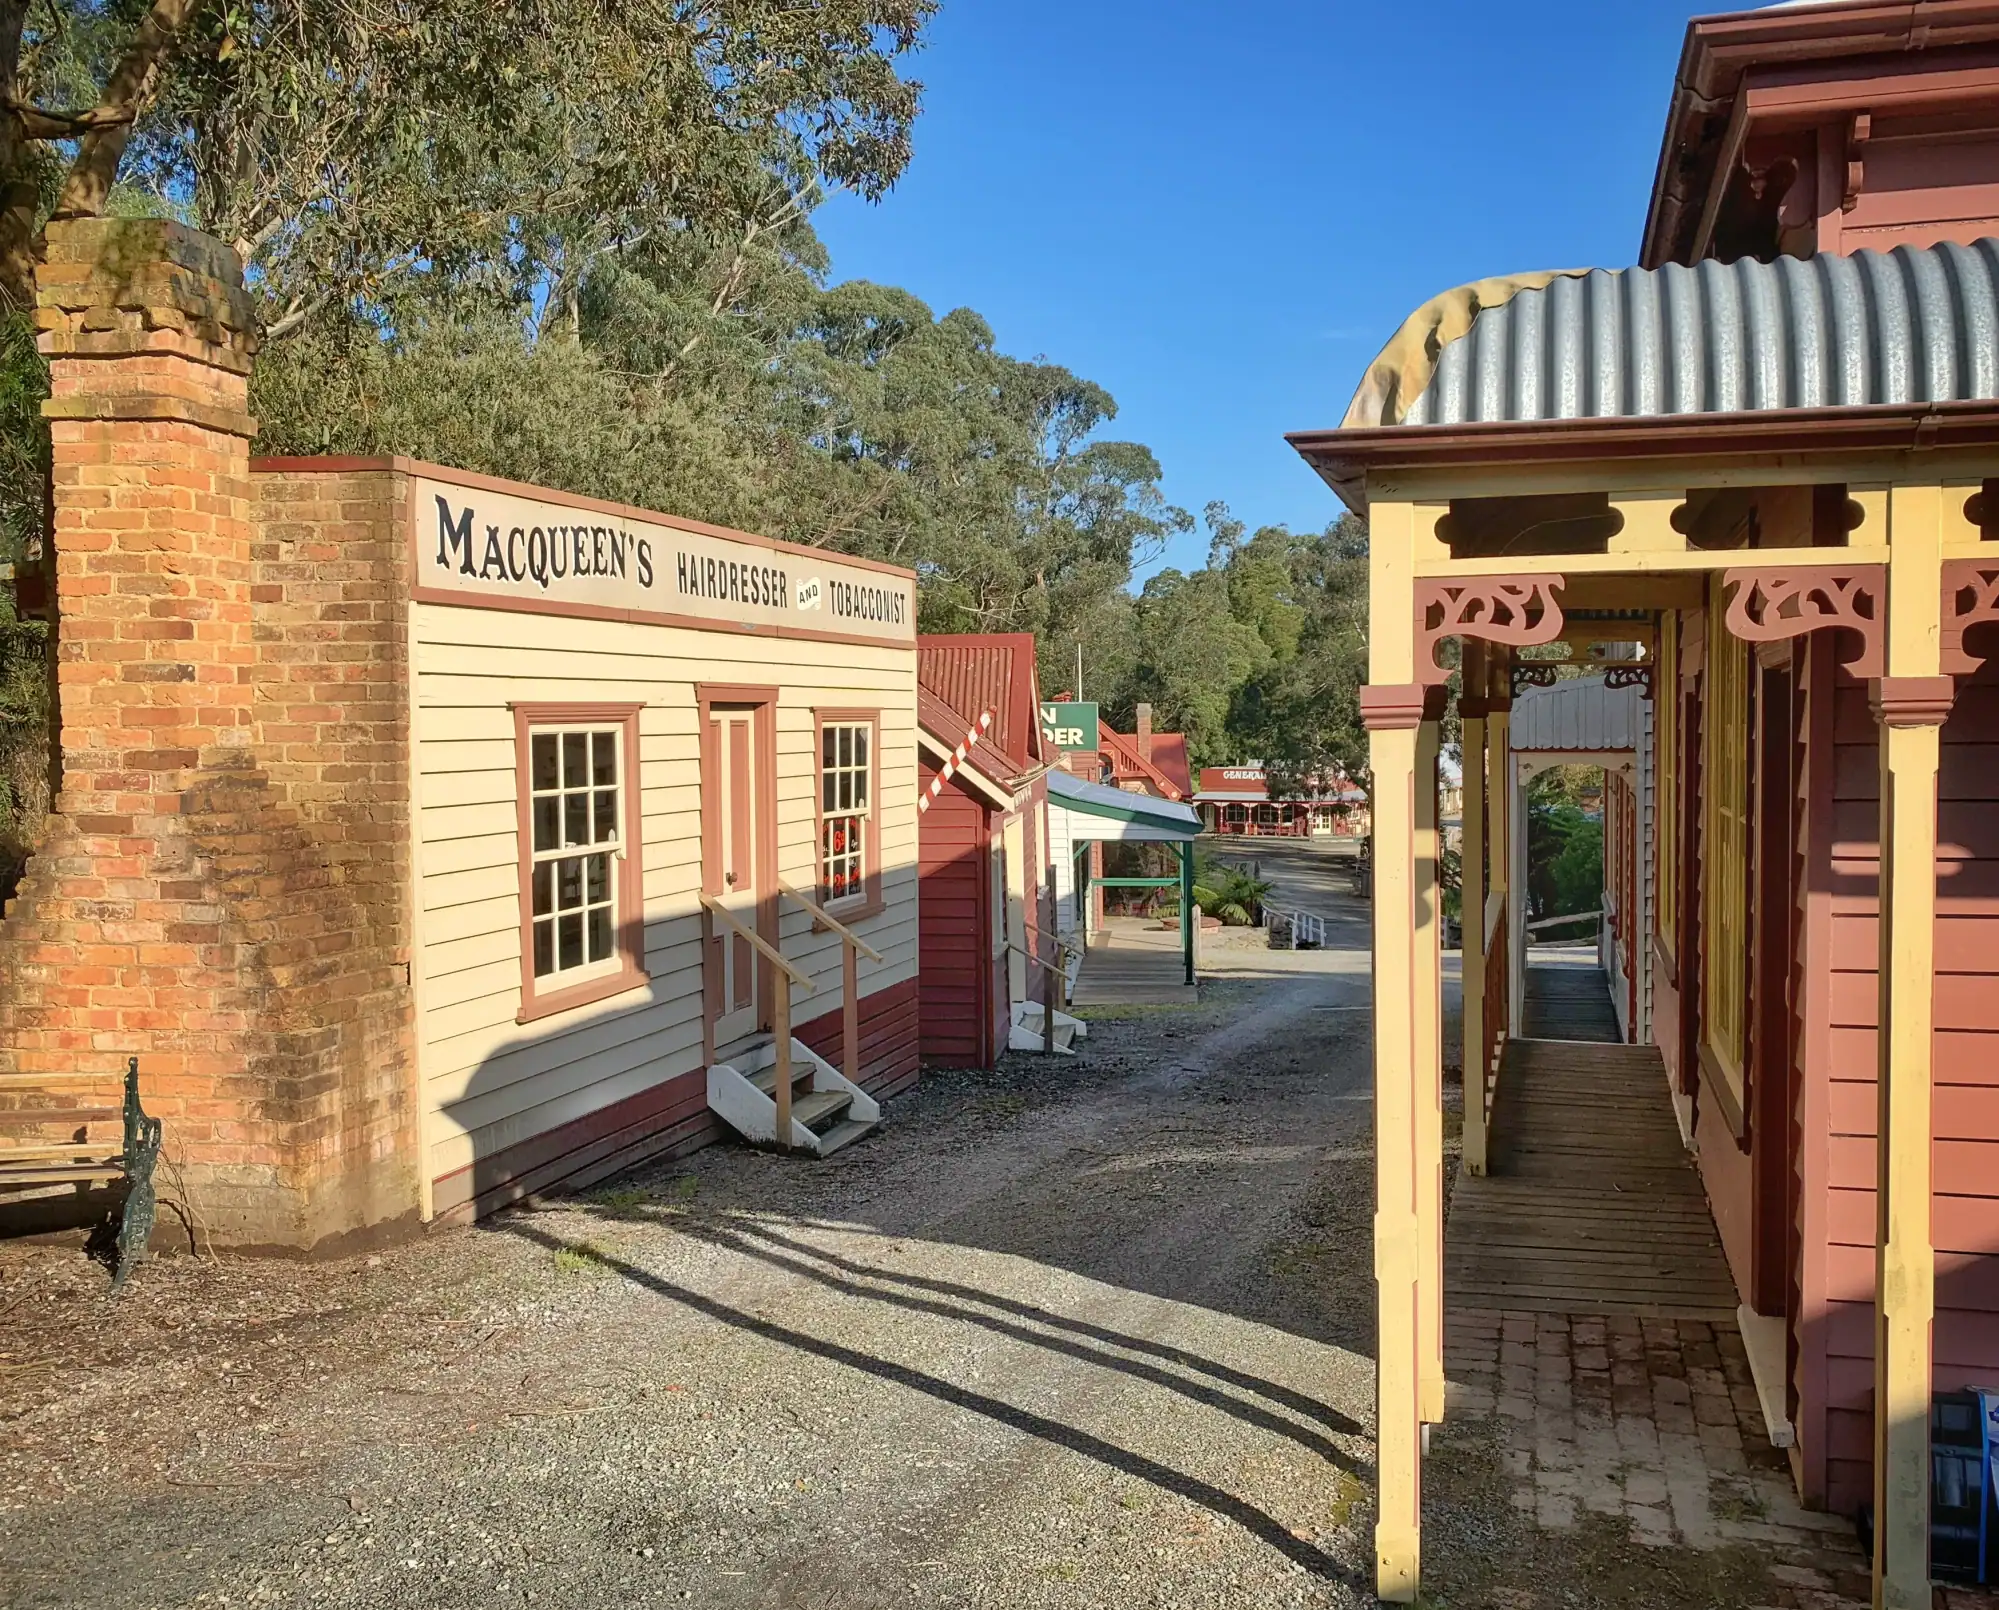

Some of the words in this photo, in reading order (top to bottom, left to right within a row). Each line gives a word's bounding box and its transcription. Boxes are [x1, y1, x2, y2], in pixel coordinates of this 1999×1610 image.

[434, 494, 654, 590] MACQUEEN'S
[677, 551, 788, 609] HAIRDRESSER
[799, 584, 818, 604] AND
[829, 580, 905, 625] TOBACCONIST
